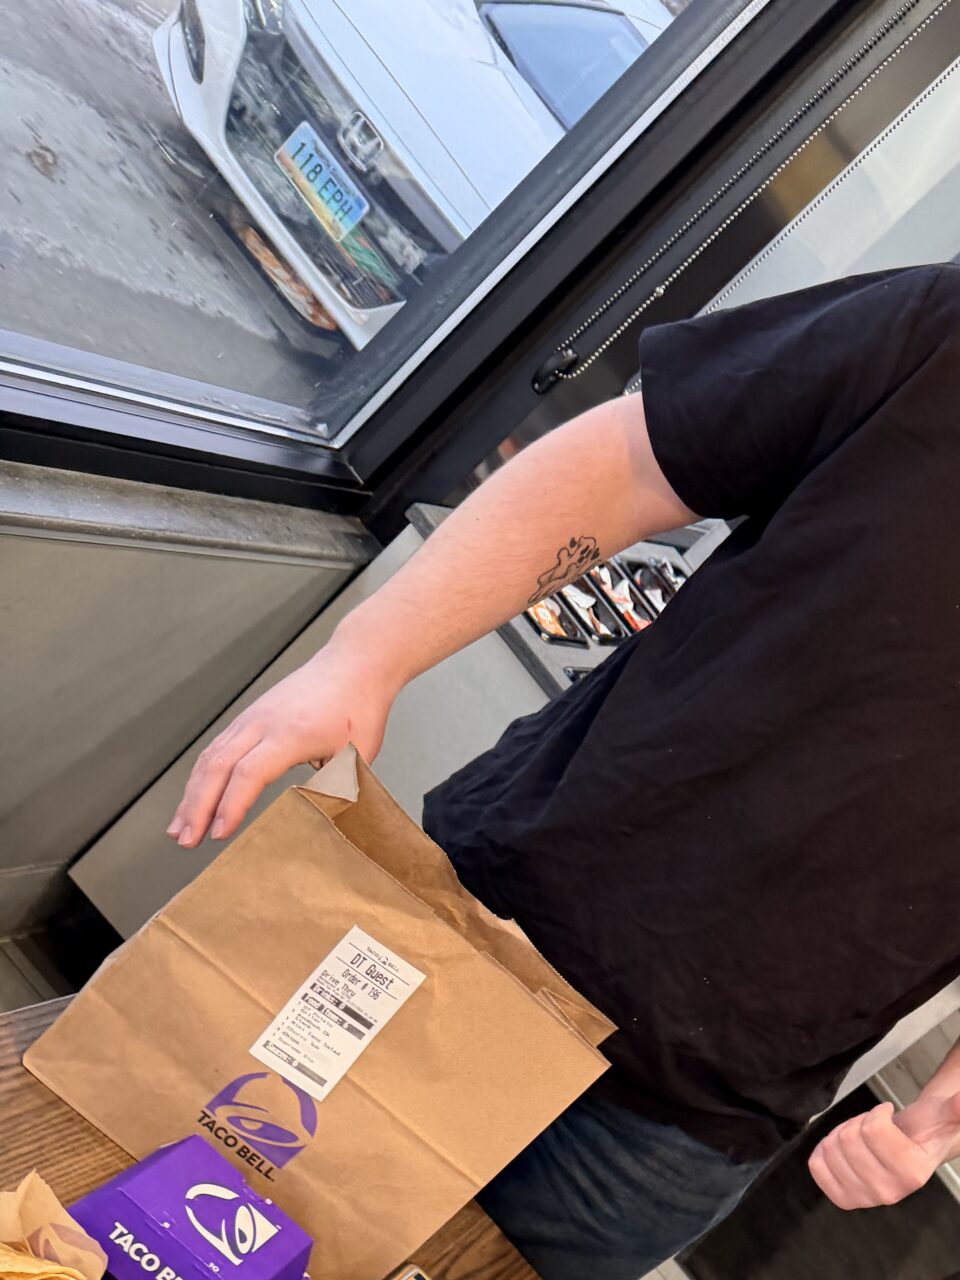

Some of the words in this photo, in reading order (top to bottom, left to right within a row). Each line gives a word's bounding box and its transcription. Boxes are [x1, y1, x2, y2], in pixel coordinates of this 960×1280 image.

[291, 142, 323, 183] 118
[317, 178, 353, 221] EPH
[321, 970, 340, 985] Drive
[341, 983, 357, 996] Thru
[341, 968, 363, 987] Order
[350, 953, 367, 969] DT
[364, 963, 395, 989] Guest
[197, 1110, 237, 1148] TACO
[236, 1144, 275, 1182] BELL
[108, 1222, 160, 1272] TACO
